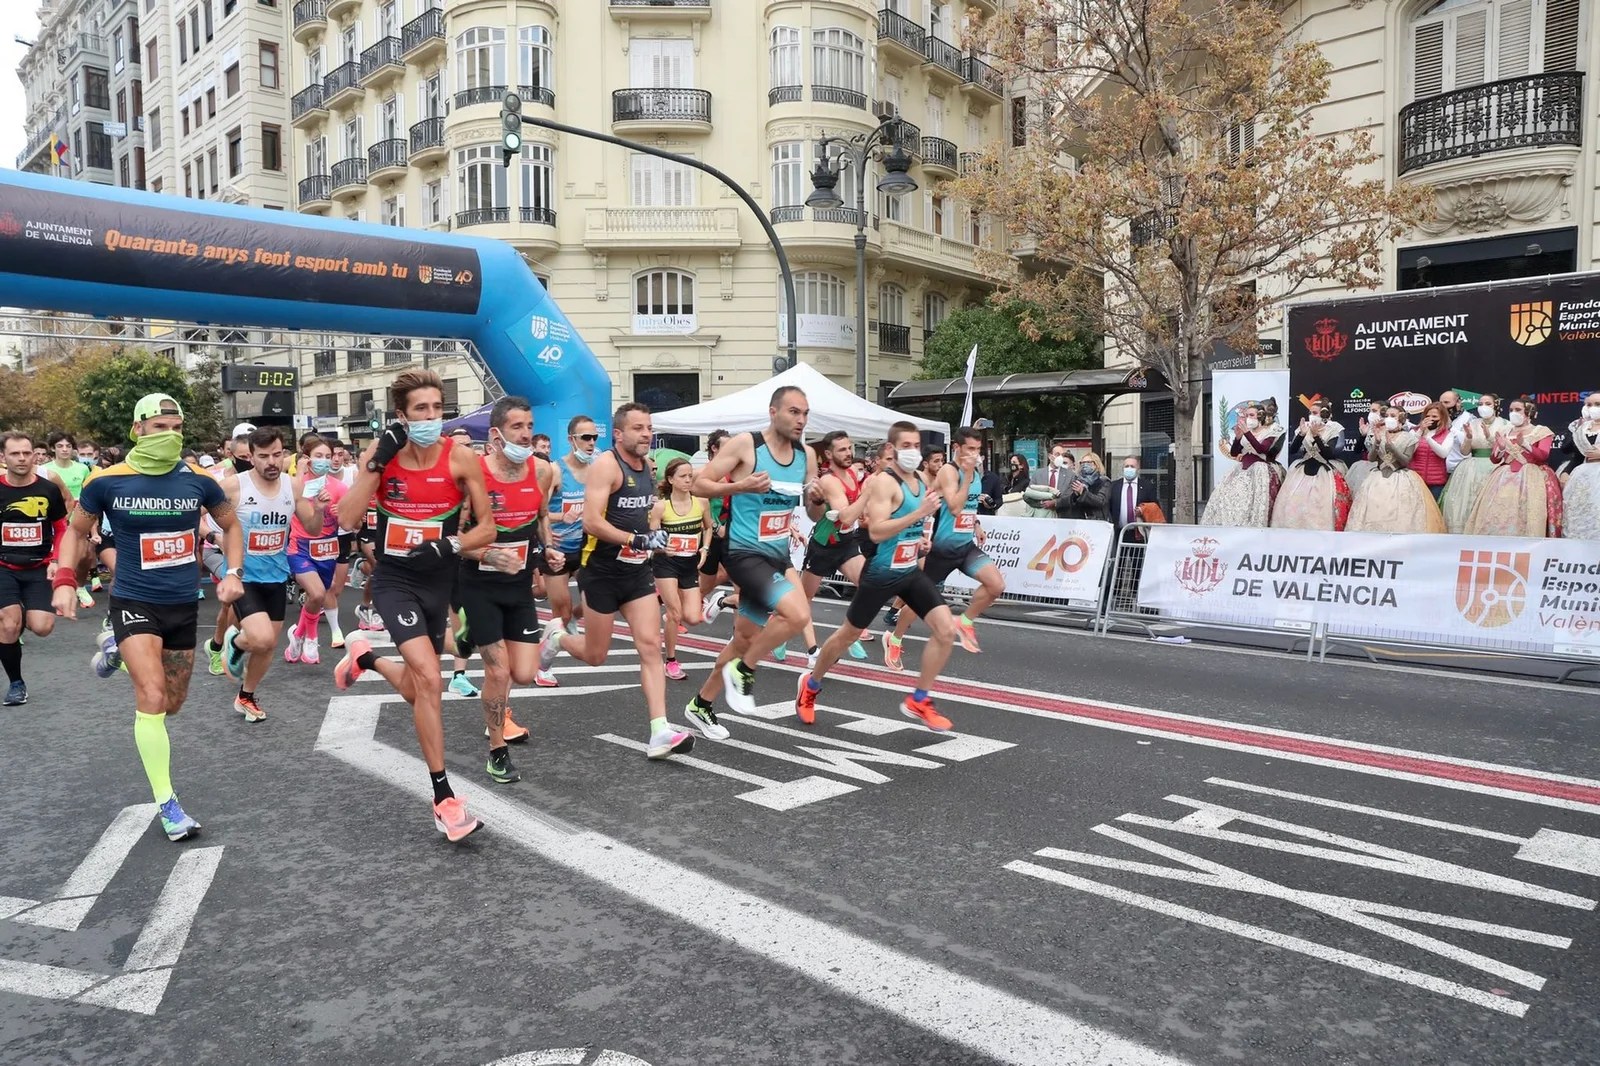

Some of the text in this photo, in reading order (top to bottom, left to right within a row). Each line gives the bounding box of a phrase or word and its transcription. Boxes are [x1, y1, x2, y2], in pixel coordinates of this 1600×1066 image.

[26, 221, 93, 237] AJUNTAMENT
[26, 230, 93, 247] DE VALÈNCIA
[105, 229, 409, 279] Quaranta anys fent esport amb tu
[1355, 314, 1469, 335] AJUNTAMENT
[1355, 331, 1469, 350] DE VALÈNCIA
[259, 372, 294, 387] 0:02
[113, 497, 199, 509] ALEJANDRO SANZ
[250, 511, 288, 525] Delta
[254, 533, 281, 547] 1065
[404, 528, 423, 545] 75
[153, 537, 186, 556] 959
[317, 543, 333, 553] 941
[1027, 534, 1089, 580] 40
[1237, 553, 1404, 580] AJUNTAMENT
[1232, 577, 1398, 608] DE VALÈNCIA
[1541, 576, 1600, 596] Espo
[1540, 594, 1600, 612] Muni
